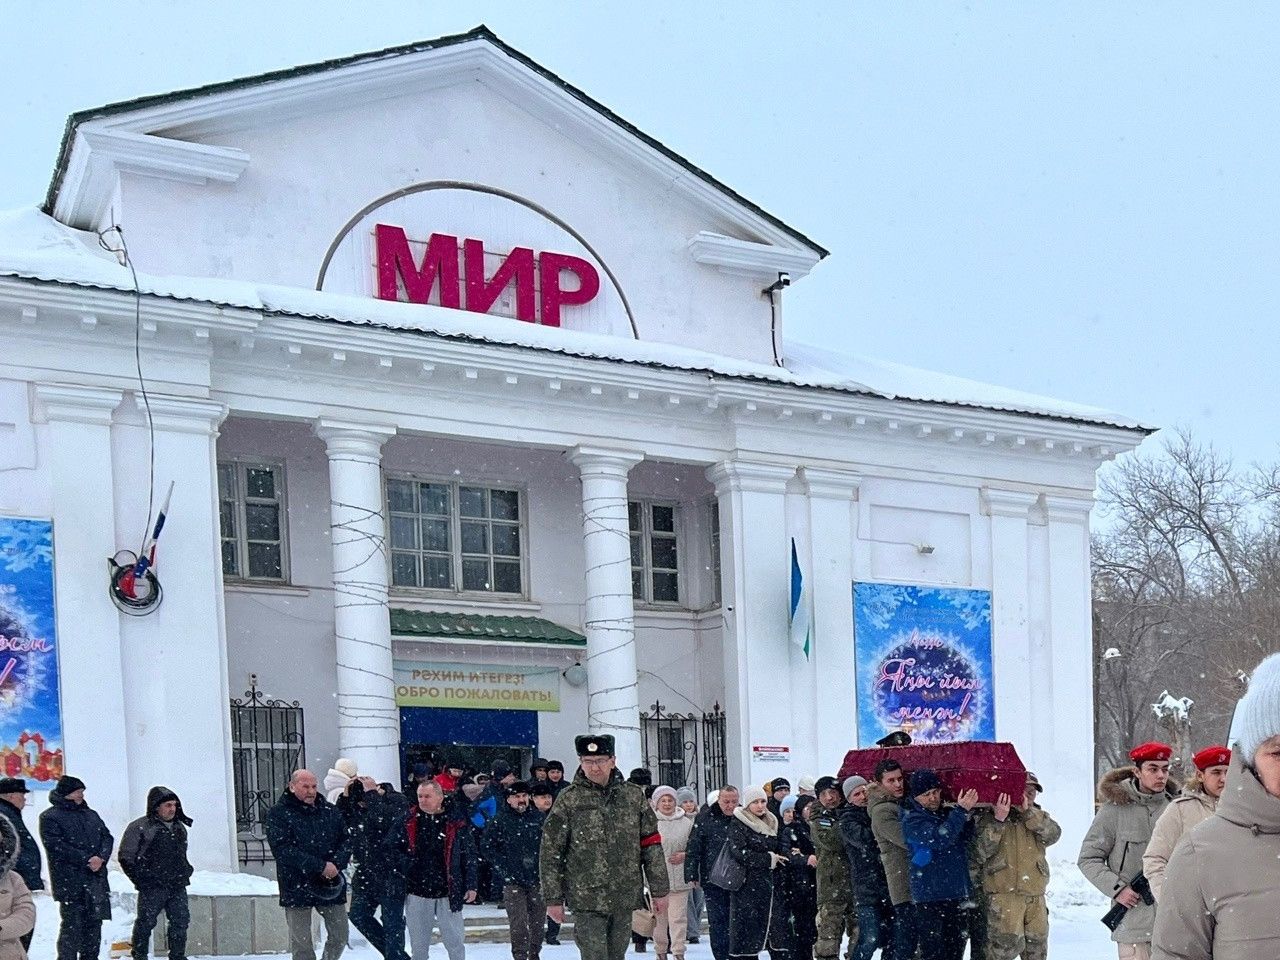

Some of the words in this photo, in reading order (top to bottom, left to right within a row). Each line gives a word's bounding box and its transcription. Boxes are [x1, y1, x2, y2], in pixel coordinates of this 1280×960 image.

[375, 223, 600, 327] МИР
[395, 686, 440, 698] ОБРО
[444, 687, 552, 702] ПОЖАЛОВАТЬ!
